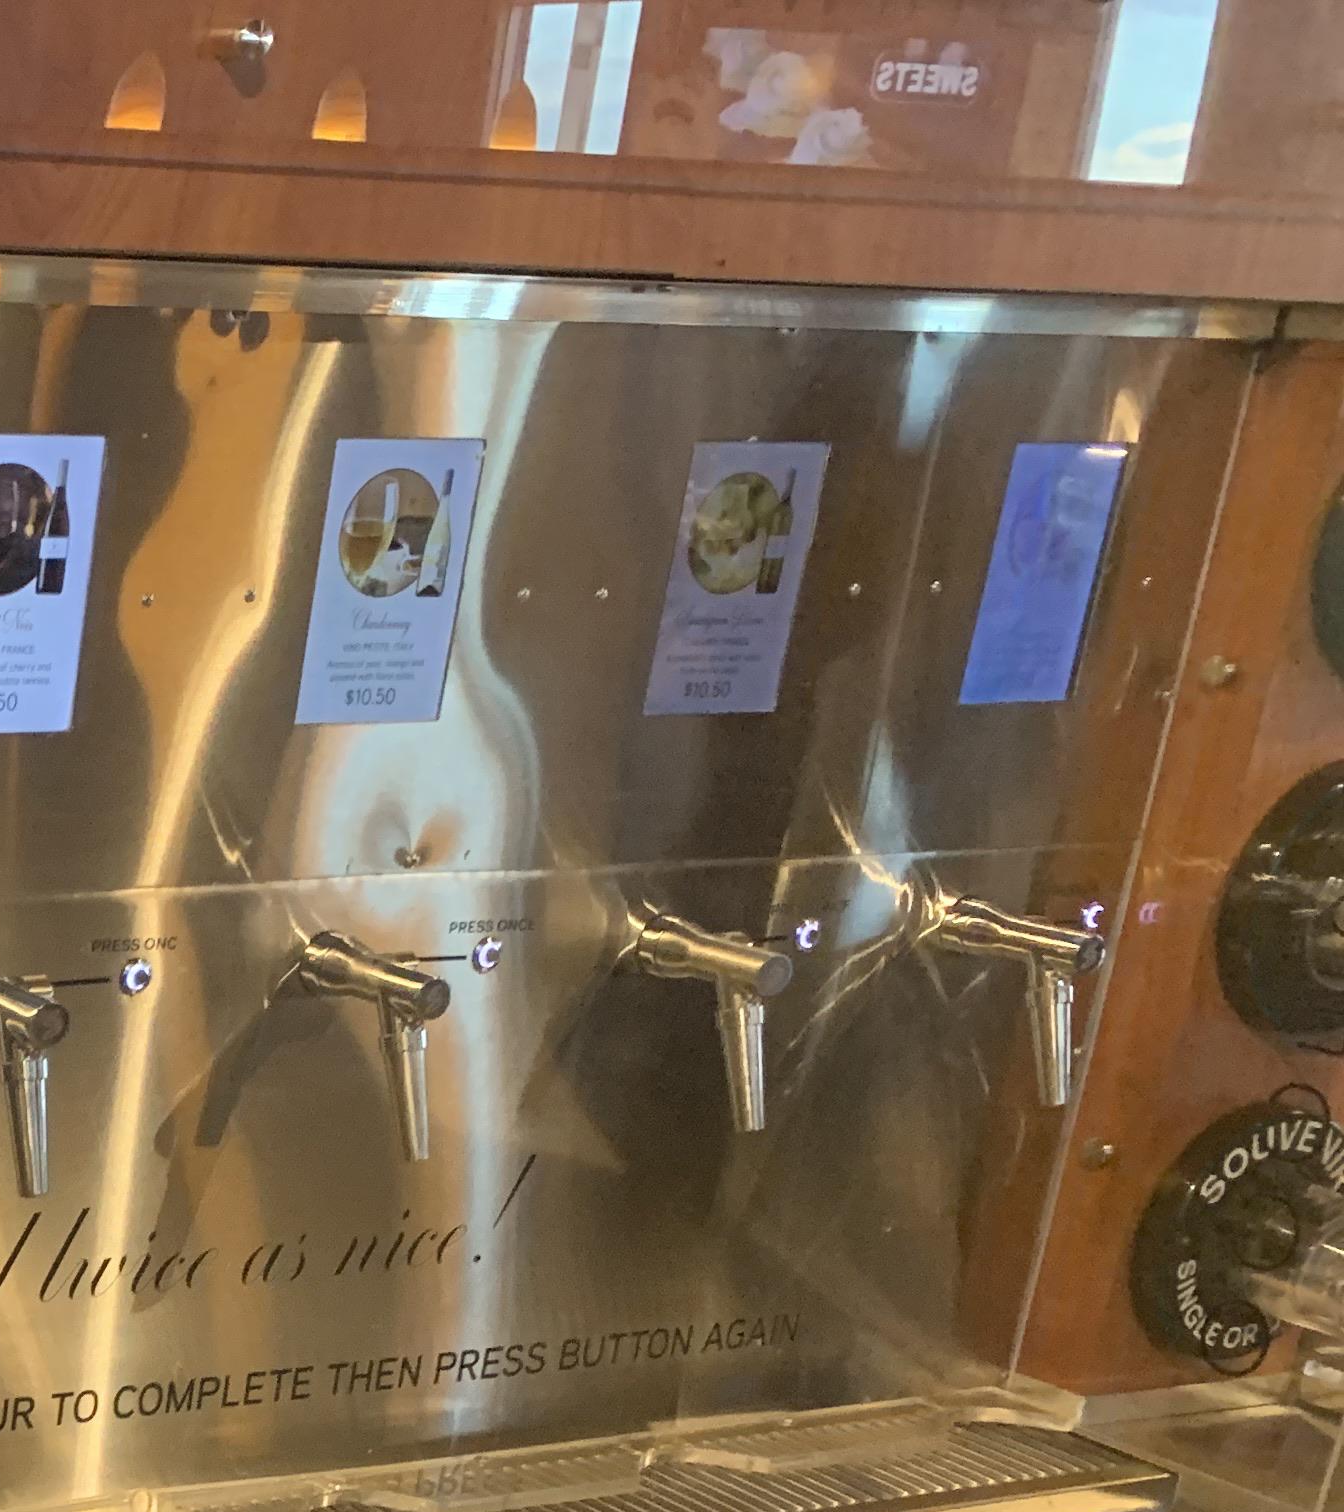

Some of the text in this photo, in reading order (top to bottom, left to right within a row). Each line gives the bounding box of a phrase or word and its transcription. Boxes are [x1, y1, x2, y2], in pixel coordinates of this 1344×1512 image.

[345, 688, 396, 706] $10.50
[91, 938, 141, 952] PRESS
[449, 919, 494, 934] PRESS
[40, 1207, 218, 1302] twice
[241, 1233, 308, 1287] as
[1177, 1259, 1223, 1347] SINGLE
[51, 1389, 99, 1427] TO
[113, 1365, 314, 1420] COMPLETE
[328, 1353, 422, 1396] THEN
[433, 1341, 547, 1386] PRESS
[558, 1324, 695, 1373] BUTTON
[702, 1312, 802, 1354] AGAIN
